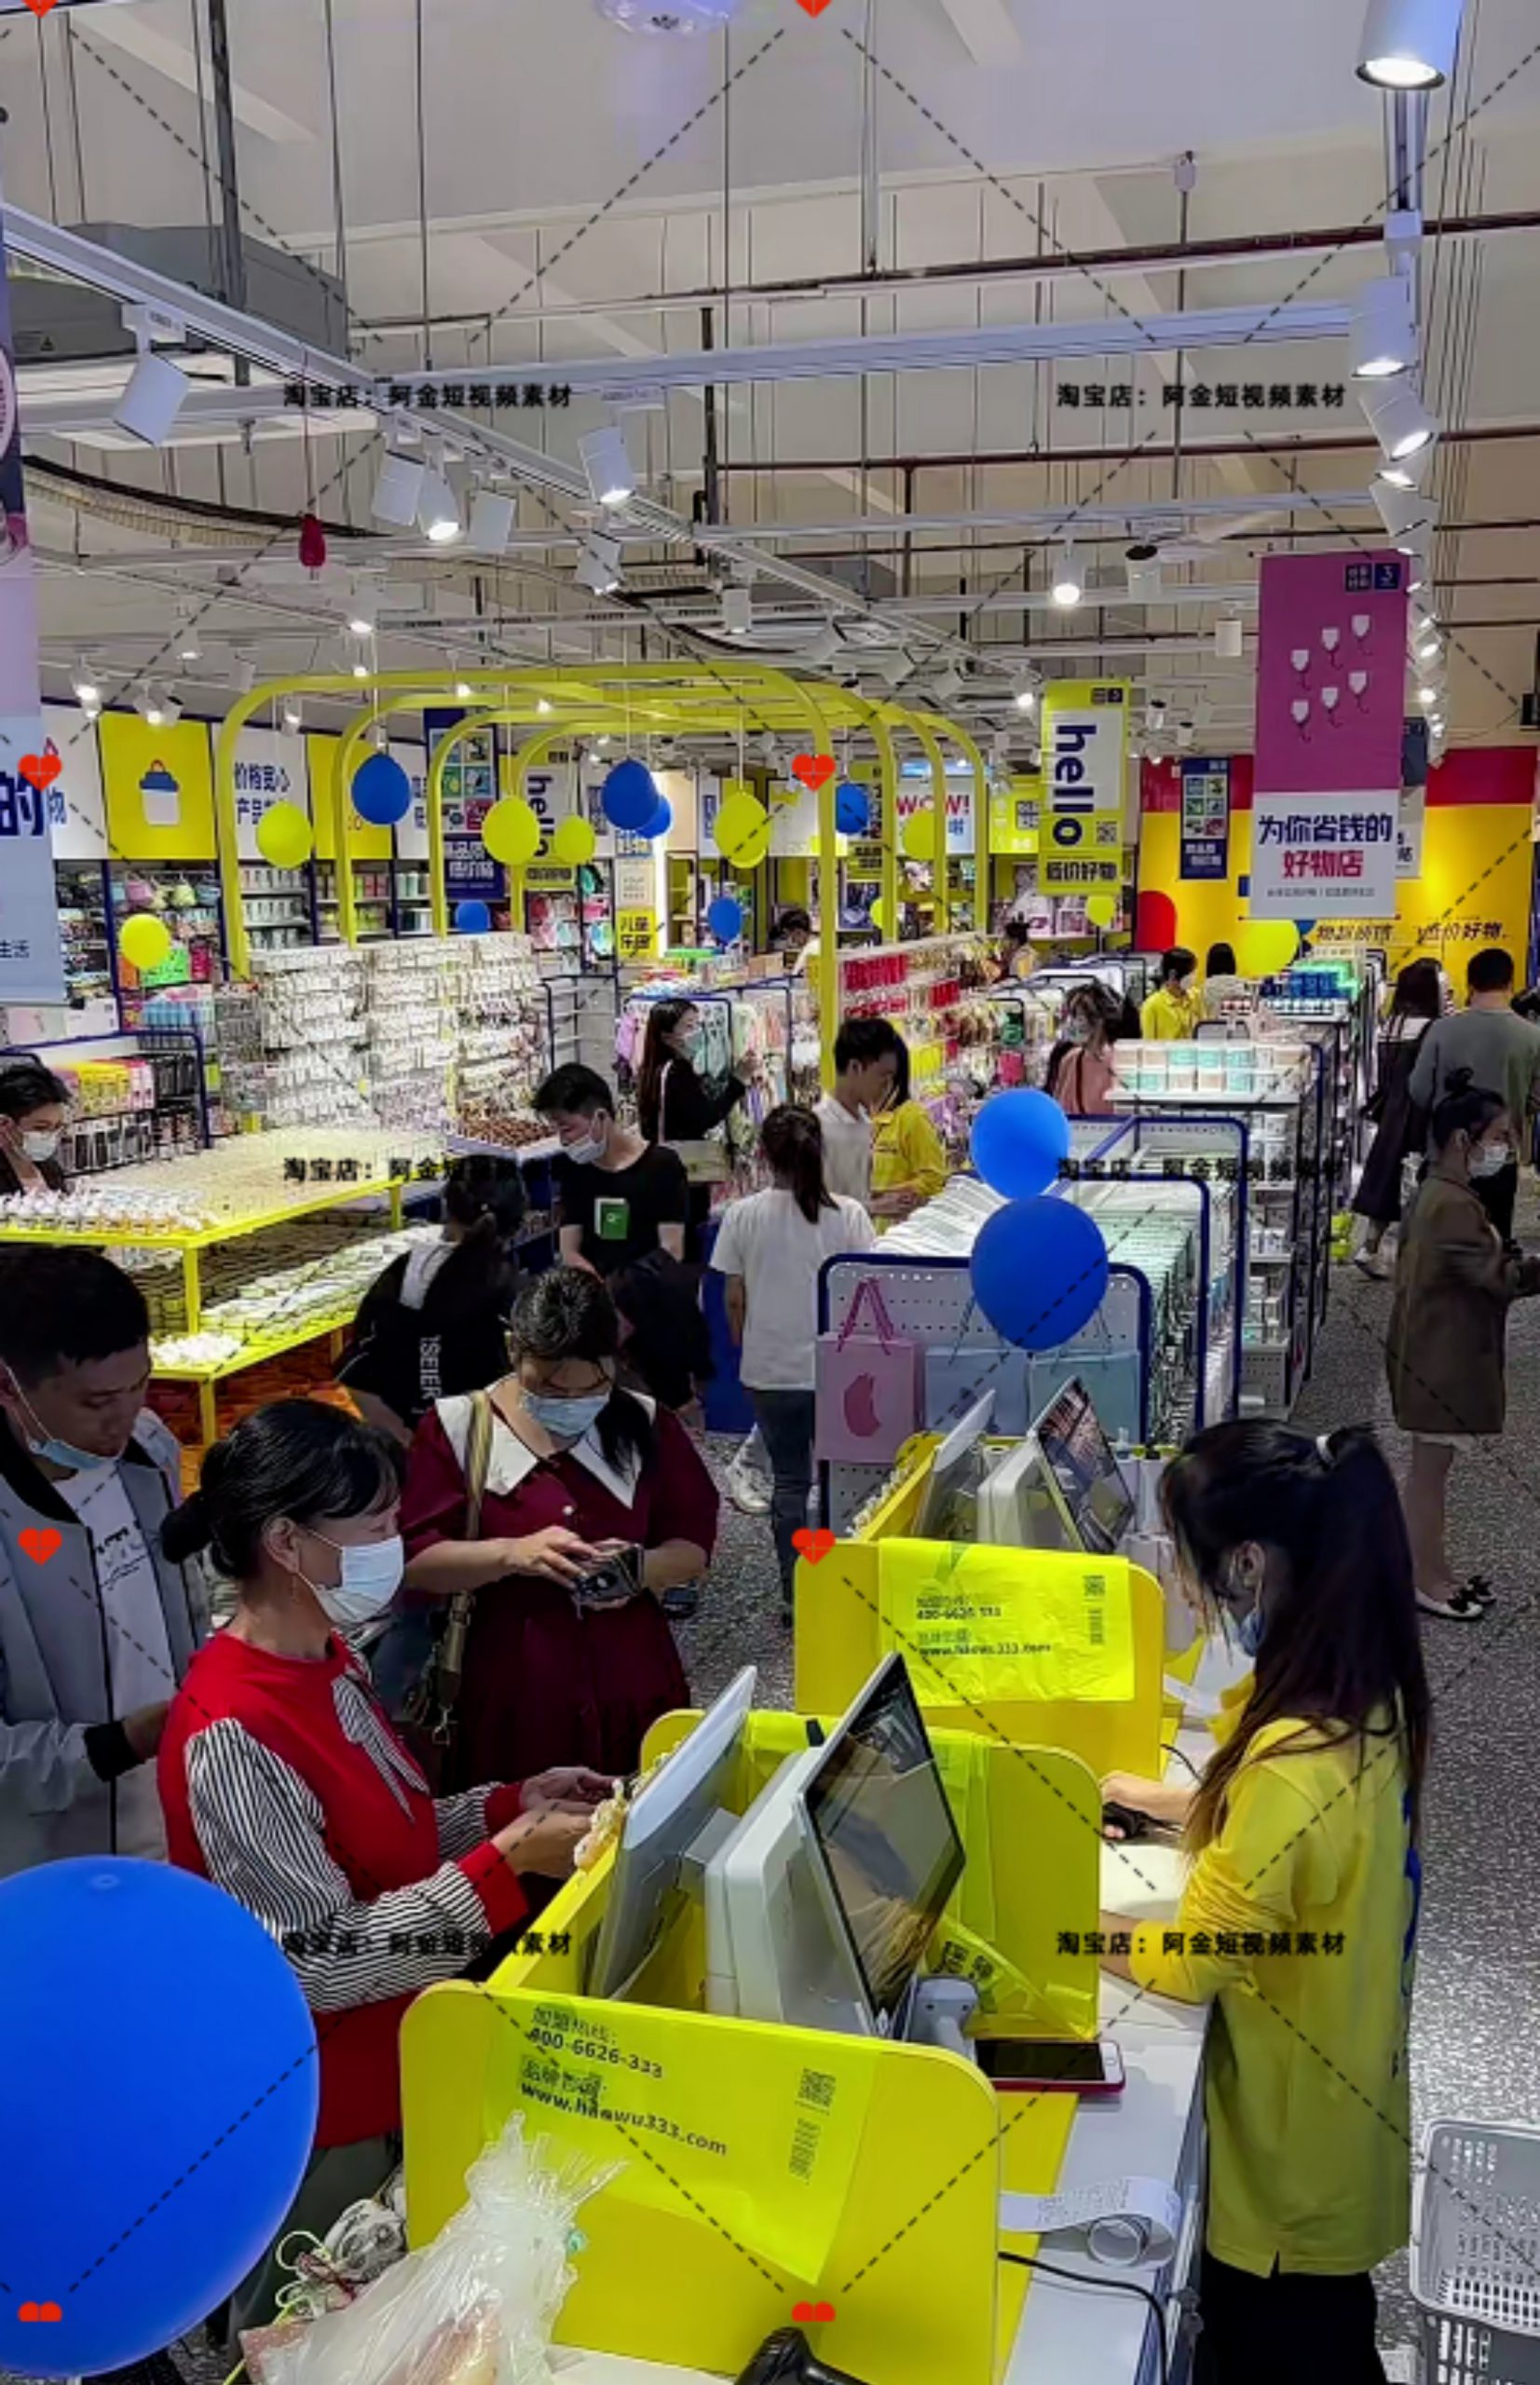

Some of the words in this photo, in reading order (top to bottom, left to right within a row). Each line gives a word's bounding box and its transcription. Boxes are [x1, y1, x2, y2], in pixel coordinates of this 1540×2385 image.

[1053, 725, 1097, 846] hello
[1258, 813, 1393, 845] 为你省钱的
[1283, 849, 1364, 878] 好物店
[529, 2027, 663, 2078] 400-6626-333
